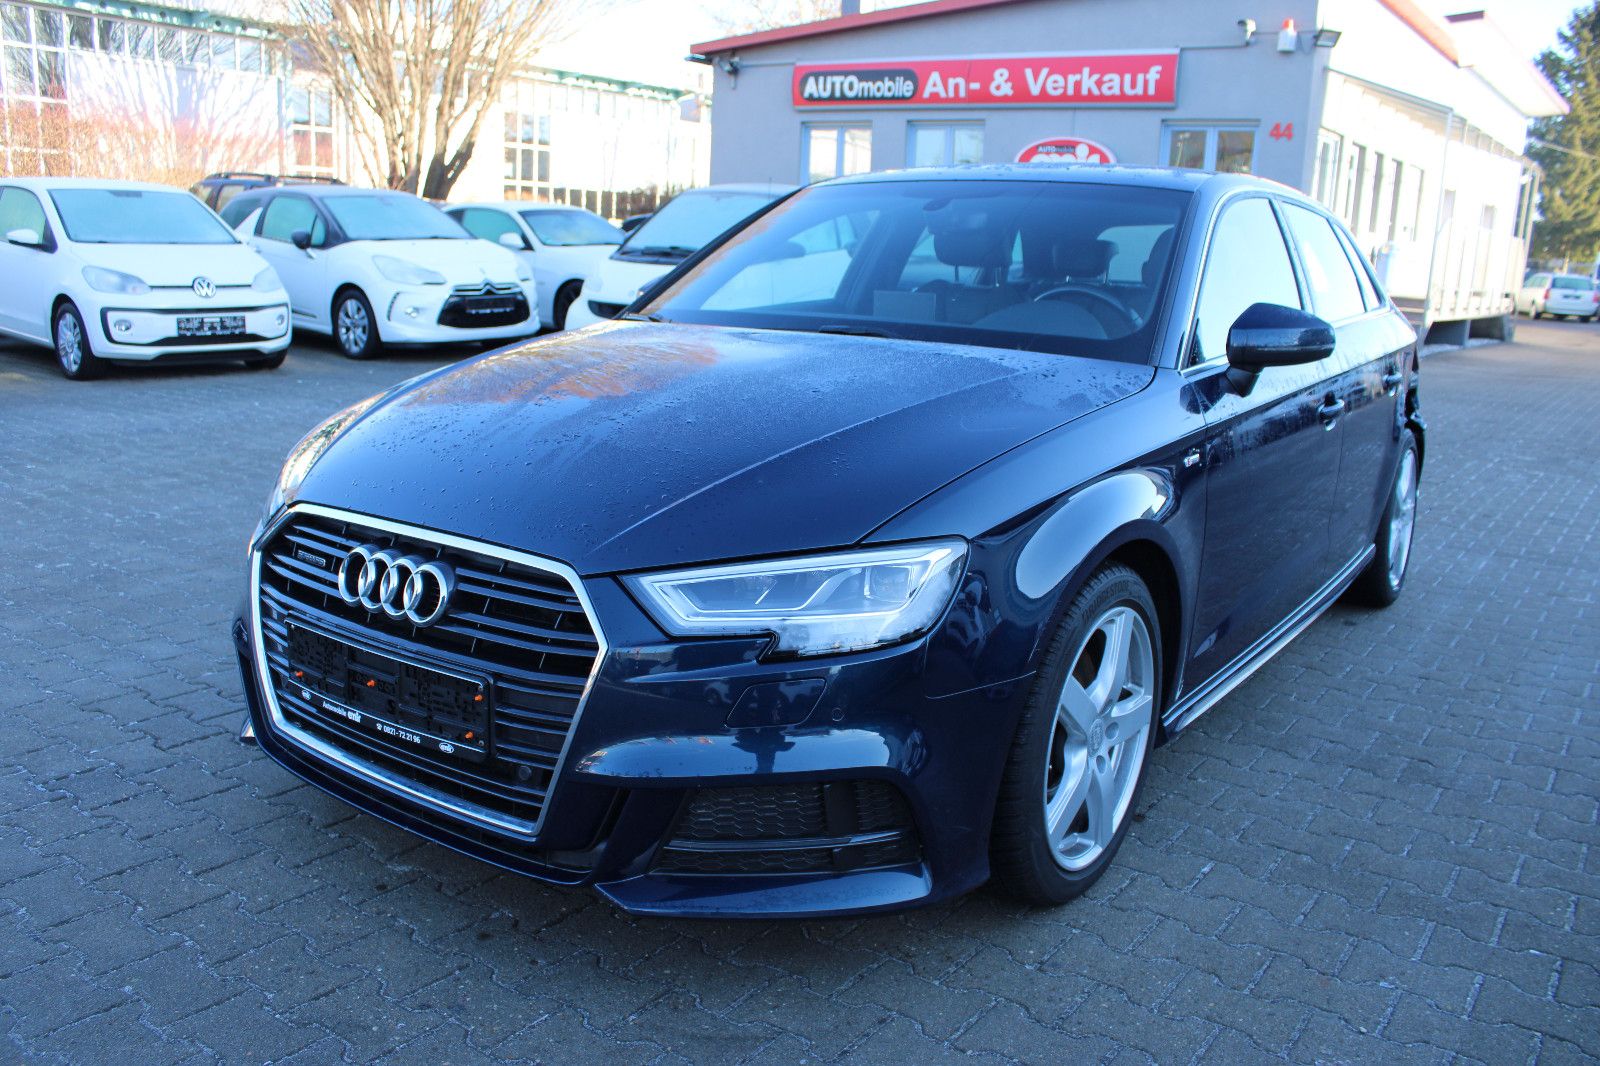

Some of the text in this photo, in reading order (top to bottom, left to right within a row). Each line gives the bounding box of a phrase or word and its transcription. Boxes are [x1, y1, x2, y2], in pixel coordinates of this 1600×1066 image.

[803, 65, 1163, 99] AUTOmobile An- & Verkauf
[1269, 122, 1294, 141] 44
